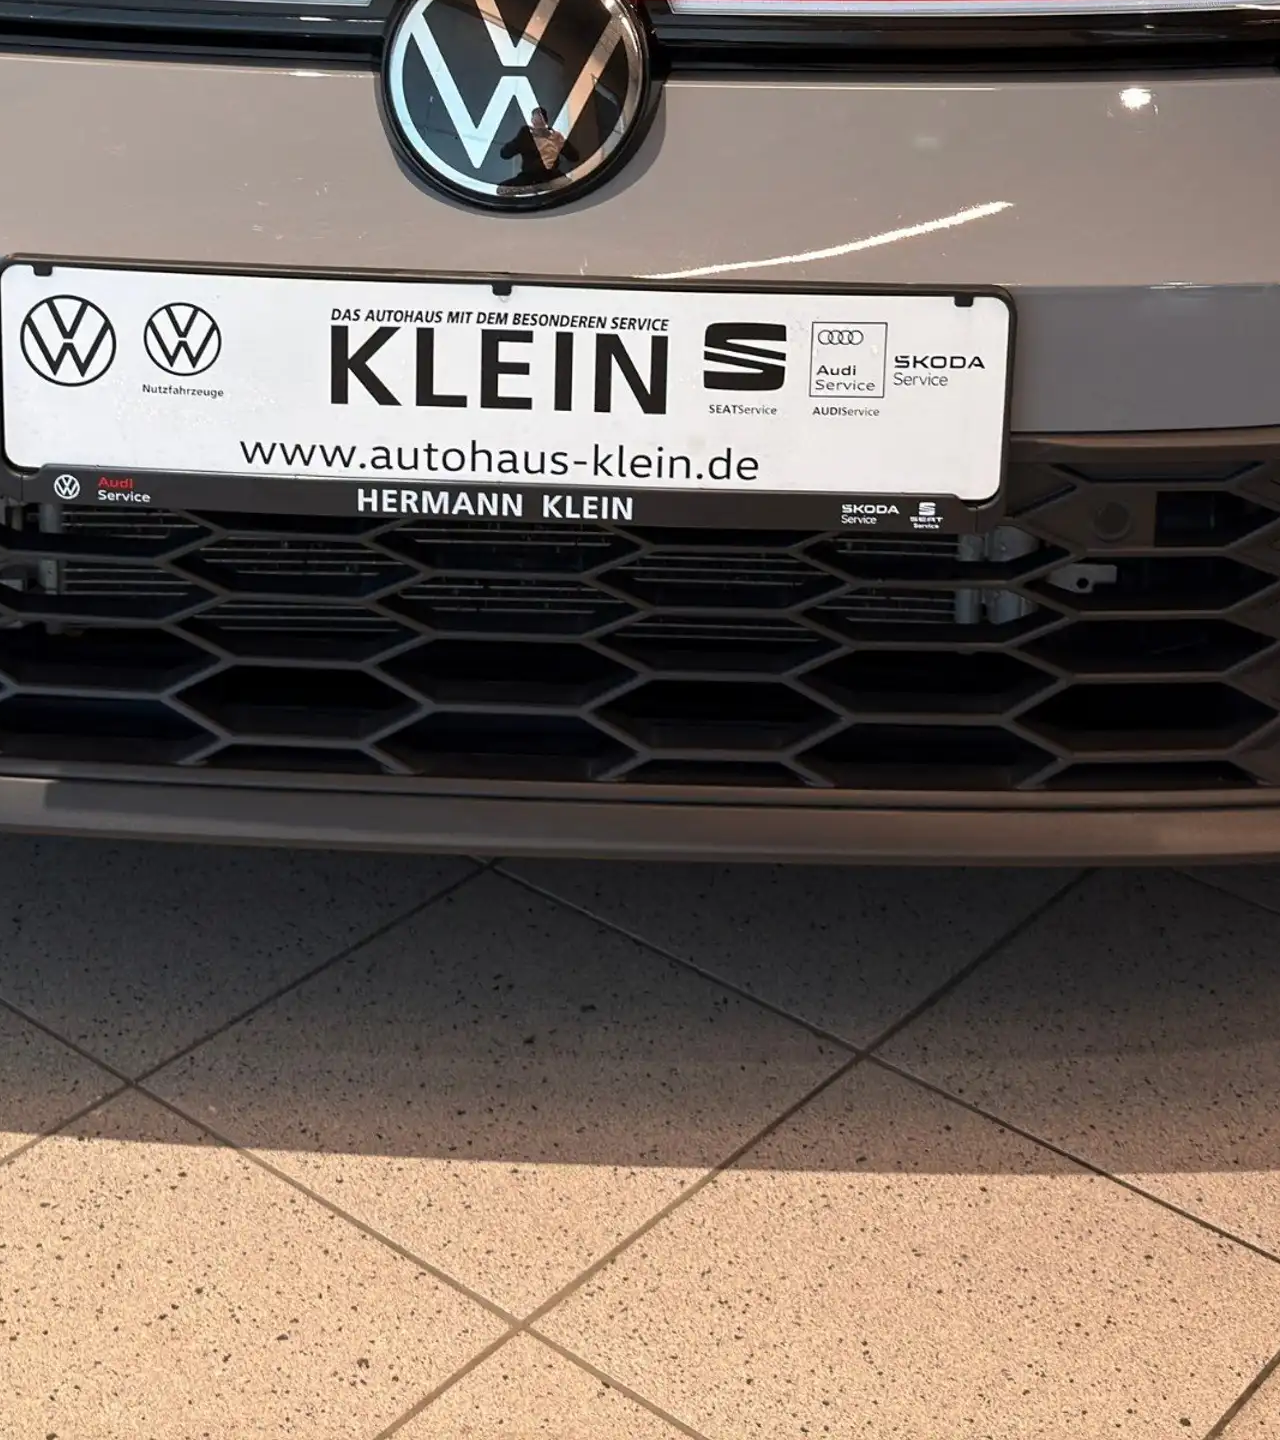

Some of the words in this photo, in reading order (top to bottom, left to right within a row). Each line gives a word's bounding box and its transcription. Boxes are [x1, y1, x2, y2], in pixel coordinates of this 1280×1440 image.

[331, 308, 361, 322] DAS
[365, 309, 443, 323] AUTOHAUS
[446, 311, 473, 324] MIT
[476, 312, 508, 326] DEM
[512, 313, 607, 329] BESONDEREN
[610, 316, 669, 332] SERVICE
[331, 326, 669, 415] KLEIN
[816, 365, 857, 377] Audi
[815, 379, 876, 392] Service
[893, 371, 949, 387] Service
[142, 383, 224, 399] Nutzfahrzeuge
[239, 438, 760, 482] www.autohaus-klein.de
[98, 476, 134, 489] Audi
[97, 489, 151, 502] Service
[357, 488, 523, 517] HERMANN
[542, 494, 633, 521] KLEIN
[841, 514, 878, 525] Service
